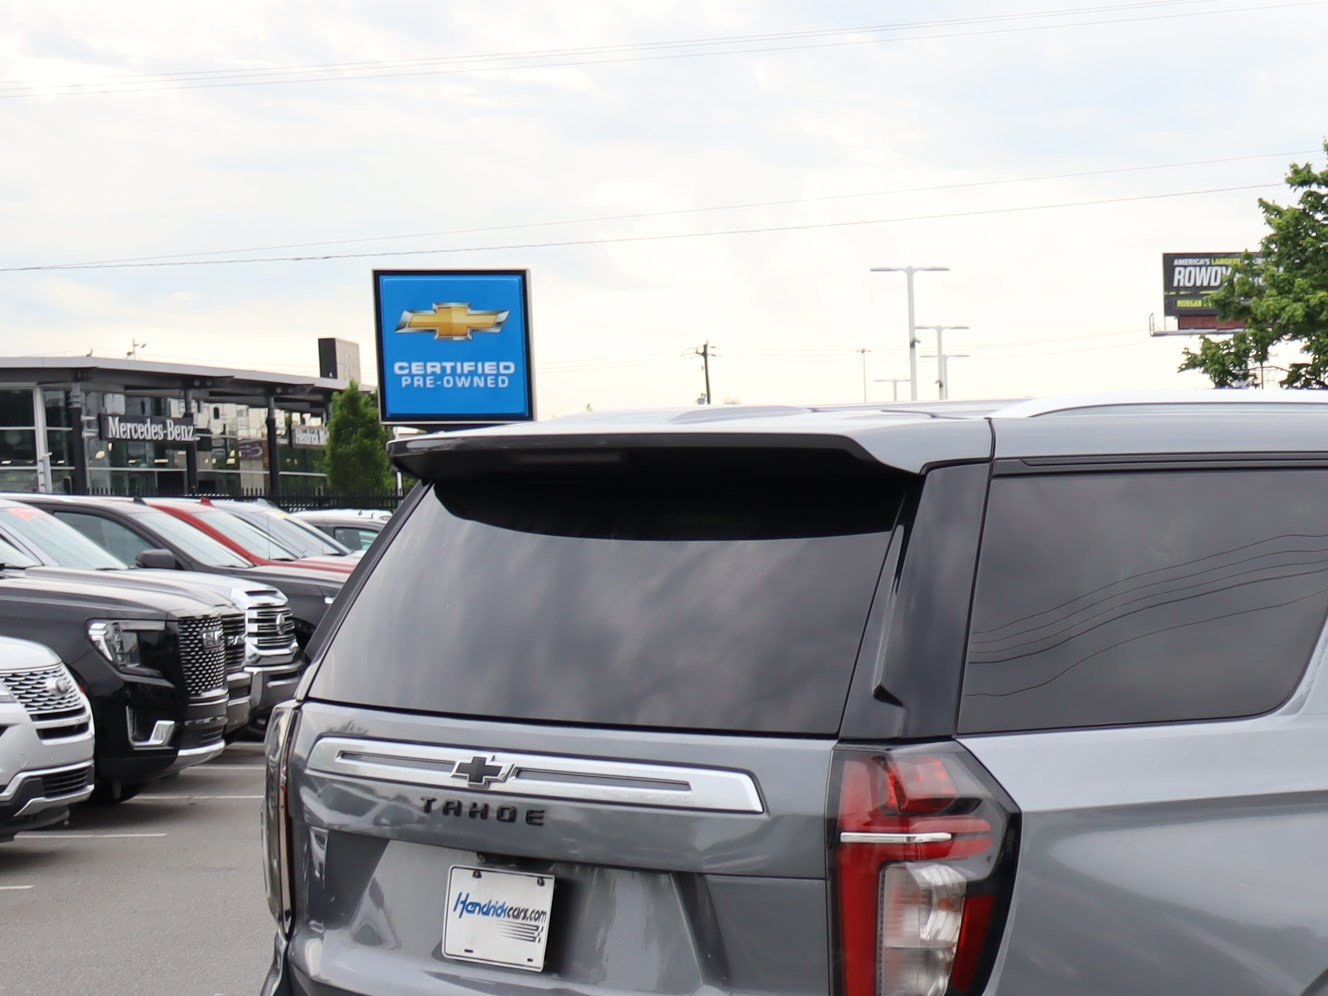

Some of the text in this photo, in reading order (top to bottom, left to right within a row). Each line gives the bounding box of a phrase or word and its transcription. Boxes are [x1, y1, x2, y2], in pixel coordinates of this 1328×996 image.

[394, 361, 516, 375] CERTIFIED
[401, 376, 509, 388] PRE-OWNED
[107, 416, 195, 442] Mercedes-Benz
[420, 797, 546, 827] TAHOE
[453, 891, 548, 924] Hendrickcars.com
